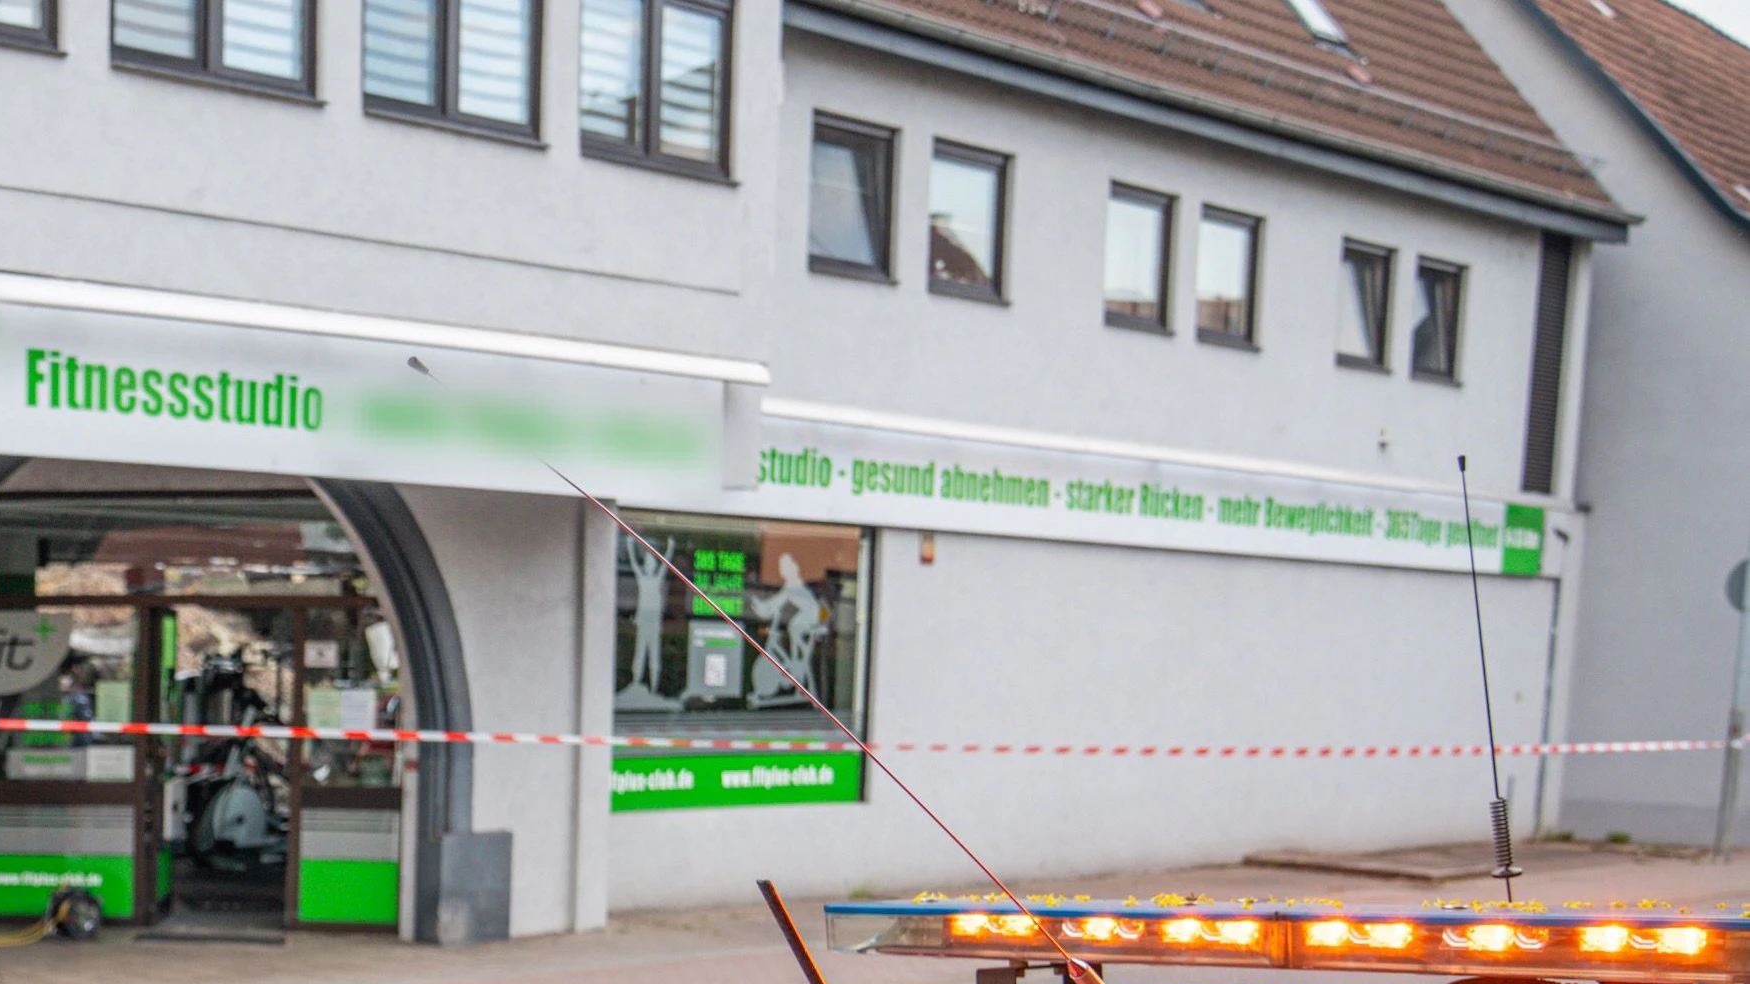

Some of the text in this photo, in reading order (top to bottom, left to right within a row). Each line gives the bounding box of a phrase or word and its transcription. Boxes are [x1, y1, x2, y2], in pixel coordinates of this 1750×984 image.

[26, 348, 323, 430] Fitnessstudio
[852, 457, 936, 496] gesund
[941, 463, 1050, 508] abnehmen
[1065, 478, 1135, 514] starker
[1139, 482, 1204, 521] Rücken
[1217, 496, 1262, 526] mehr
[1265, 496, 1375, 537] Beweglichkeit
